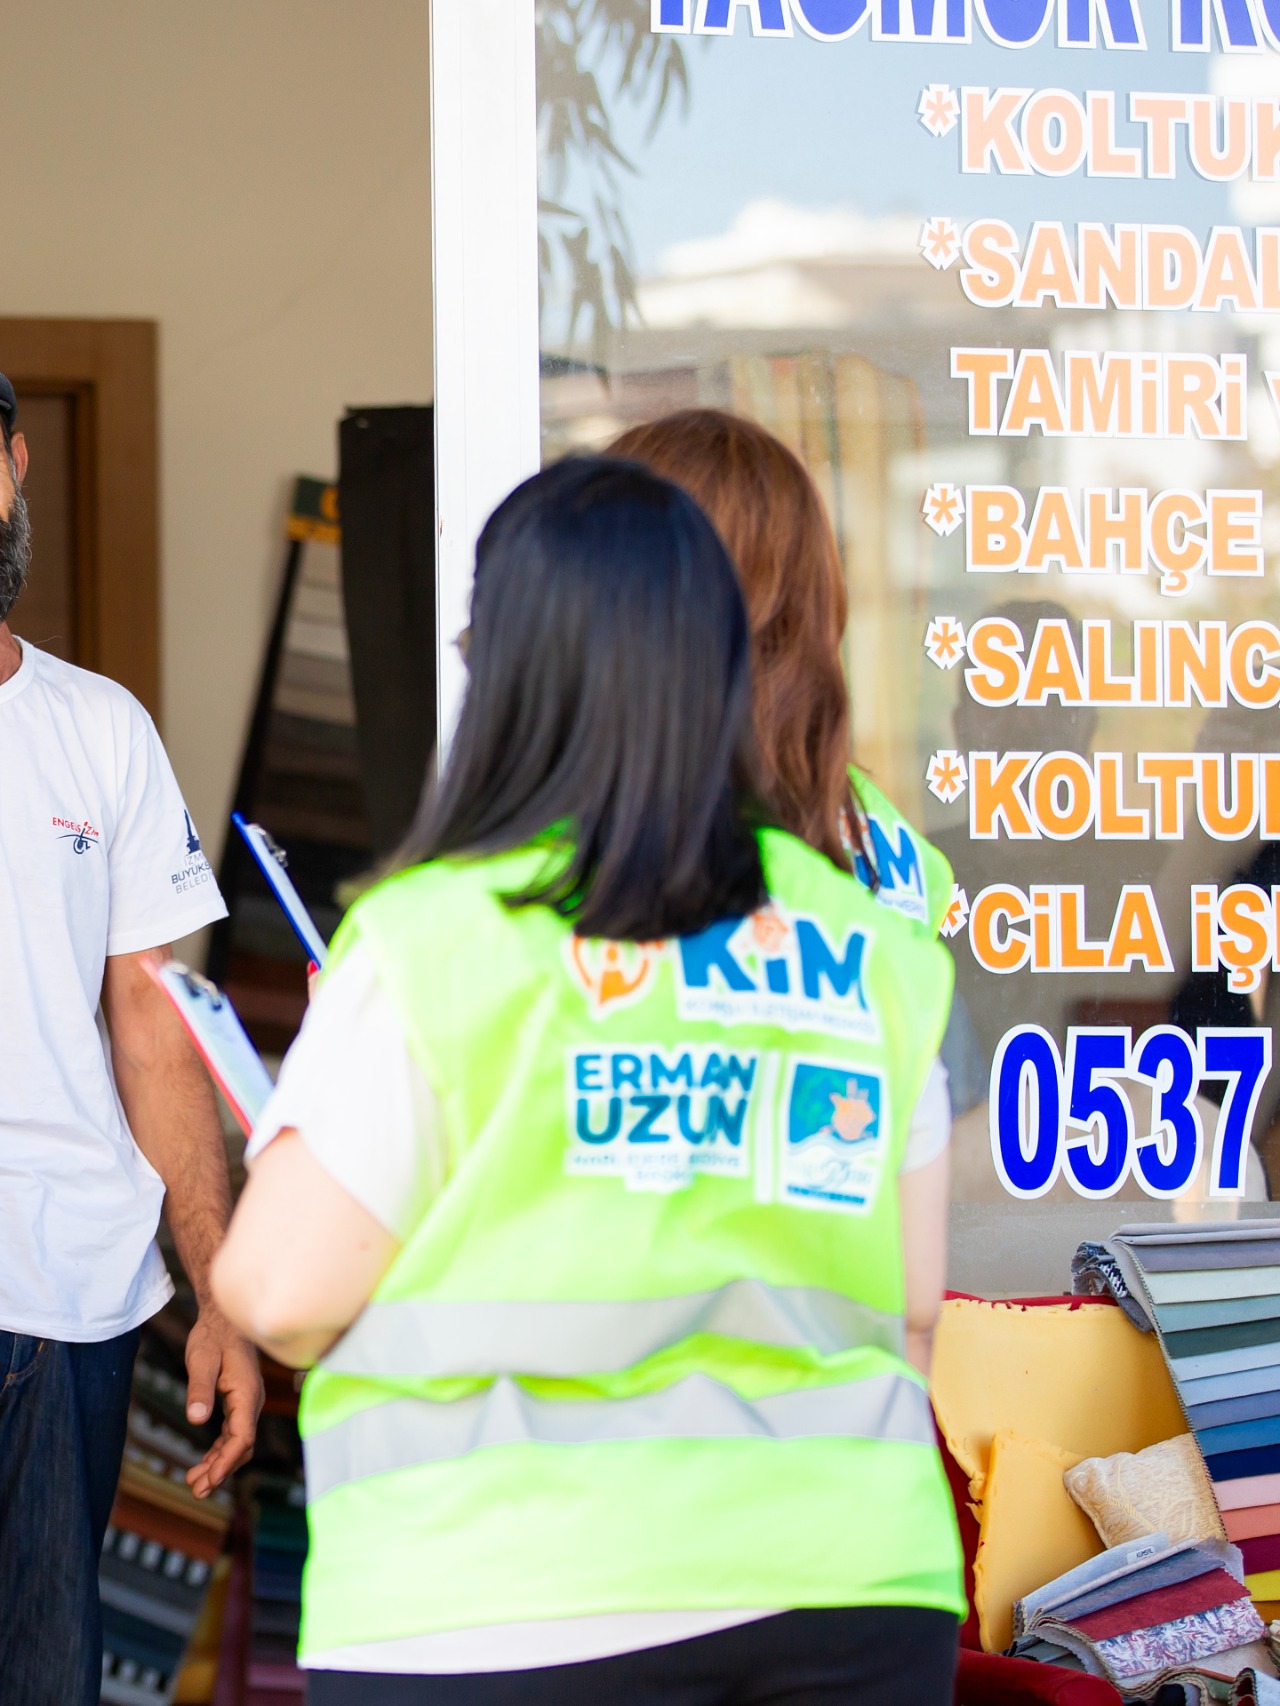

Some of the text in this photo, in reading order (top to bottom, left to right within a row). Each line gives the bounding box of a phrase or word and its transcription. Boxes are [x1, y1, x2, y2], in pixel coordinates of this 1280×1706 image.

[966, 485, 1264, 597] BAHÇE
[965, 617, 1280, 709] SALINC
[1191, 884, 1280, 994] iŞ
[575, 1052, 757, 1092] ERMAN
[575, 1093, 748, 1147] UZUN
[989, 1023, 1273, 1200] 0537
